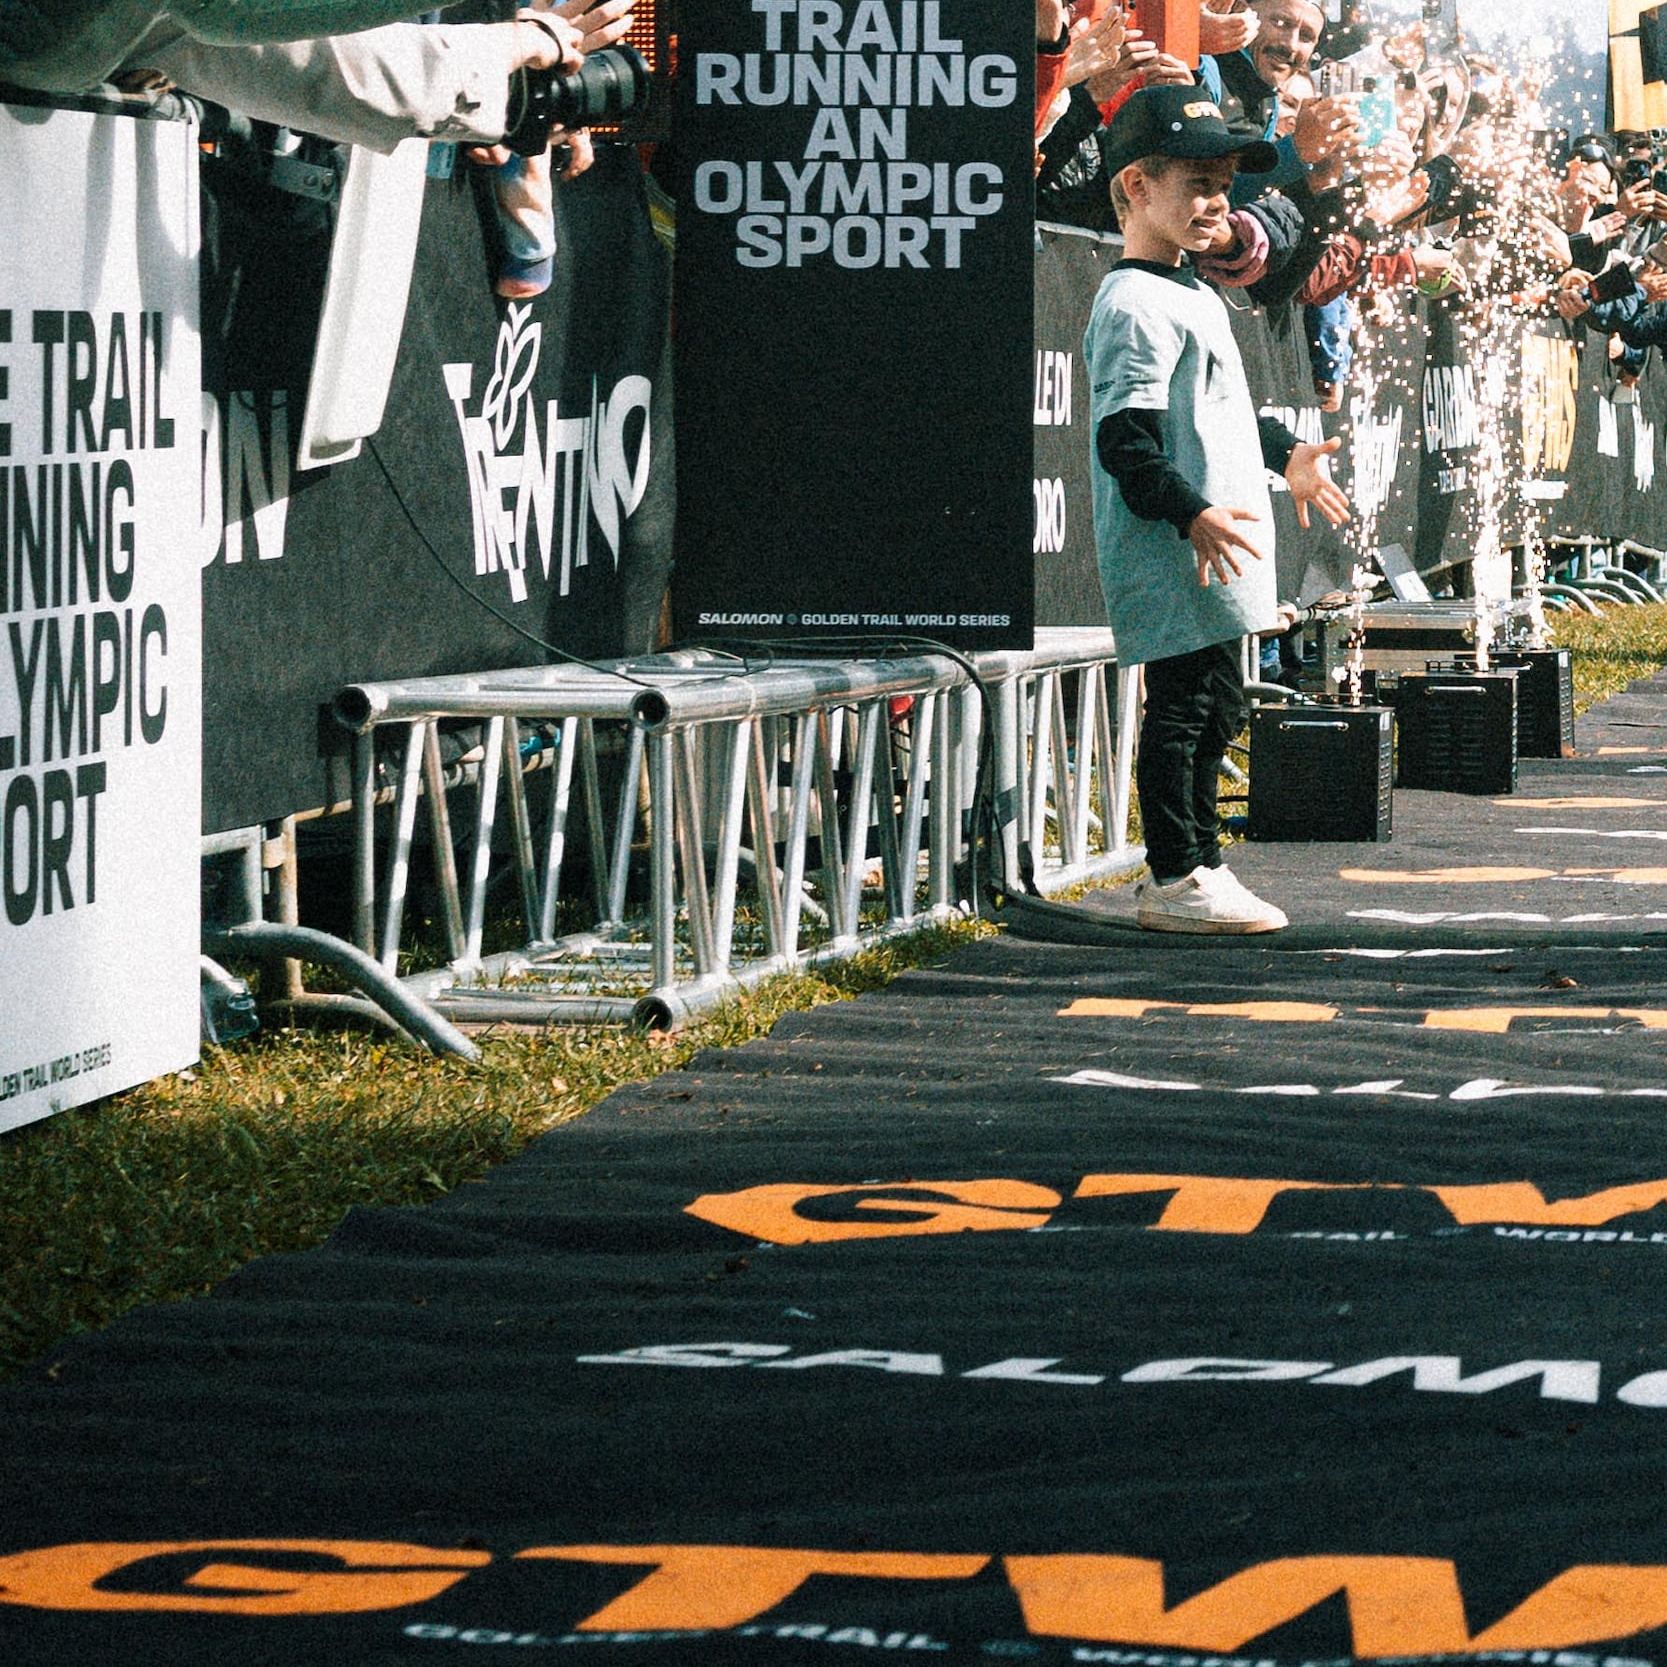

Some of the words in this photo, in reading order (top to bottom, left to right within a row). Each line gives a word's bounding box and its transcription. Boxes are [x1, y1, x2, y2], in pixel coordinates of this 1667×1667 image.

[752, 0, 963, 52] TRAIL
[696, 53, 1017, 108] RUNNING
[804, 107, 906, 160] AN
[695, 161, 1003, 216] OLYMPIC
[736, 214, 976, 269] SPORT
[33, 308, 174, 454] TRAIL
[0, 459, 134, 614] NING
[698, 612, 784, 626] SALOMON
[801, 613, 859, 626] GOLDEN
[862, 613, 902, 626] TRAIL
[904, 614, 956, 627] WORLD
[959, 614, 1010, 627] SERIES
[3, 761, 106, 926] ORT
